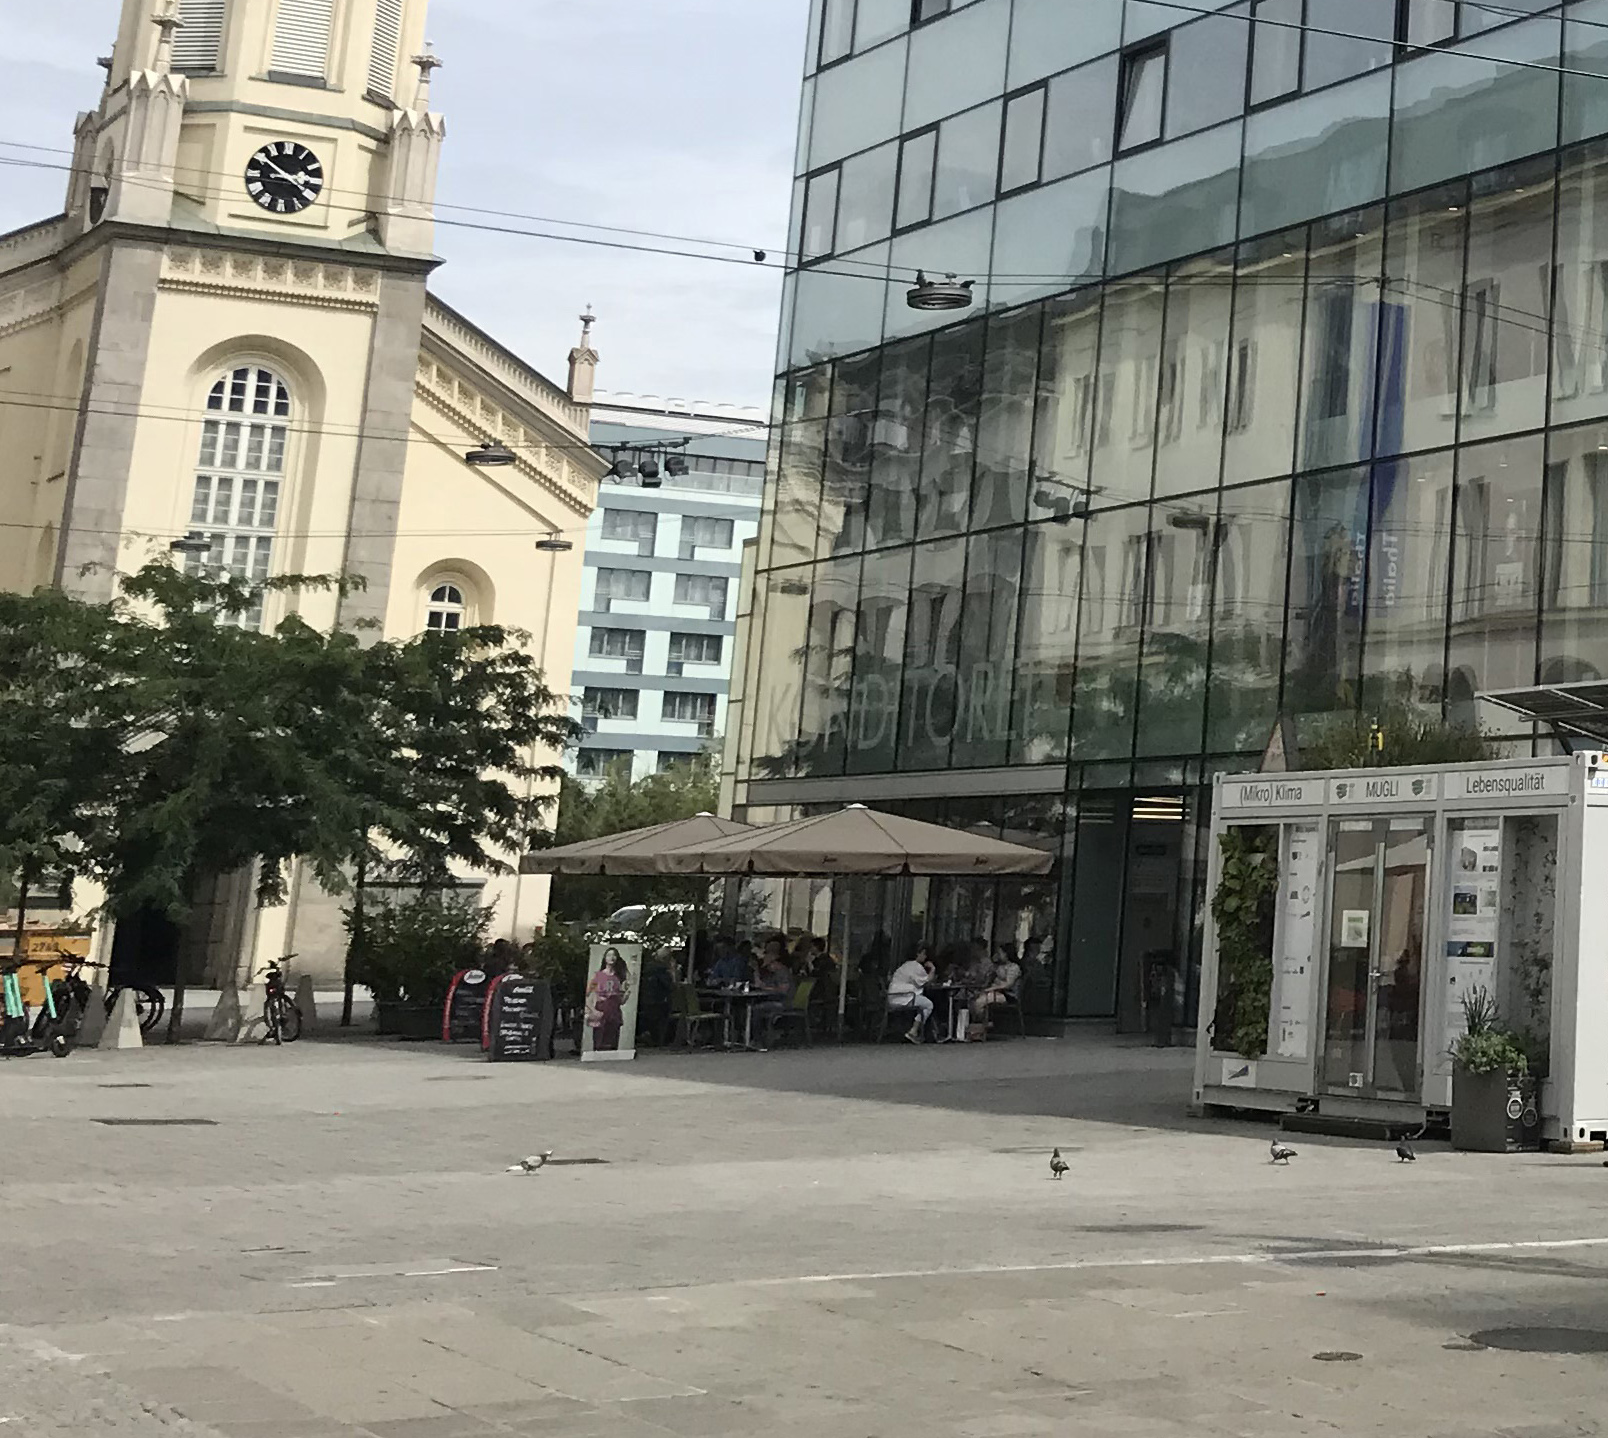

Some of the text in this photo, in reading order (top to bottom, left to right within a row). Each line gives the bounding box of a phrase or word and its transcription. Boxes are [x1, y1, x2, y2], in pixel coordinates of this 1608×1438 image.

[1275, 783, 1303, 801] Klima
[1365, 780, 1399, 798] MUGLI
[1465, 772, 1546, 796] Lebensqualität
